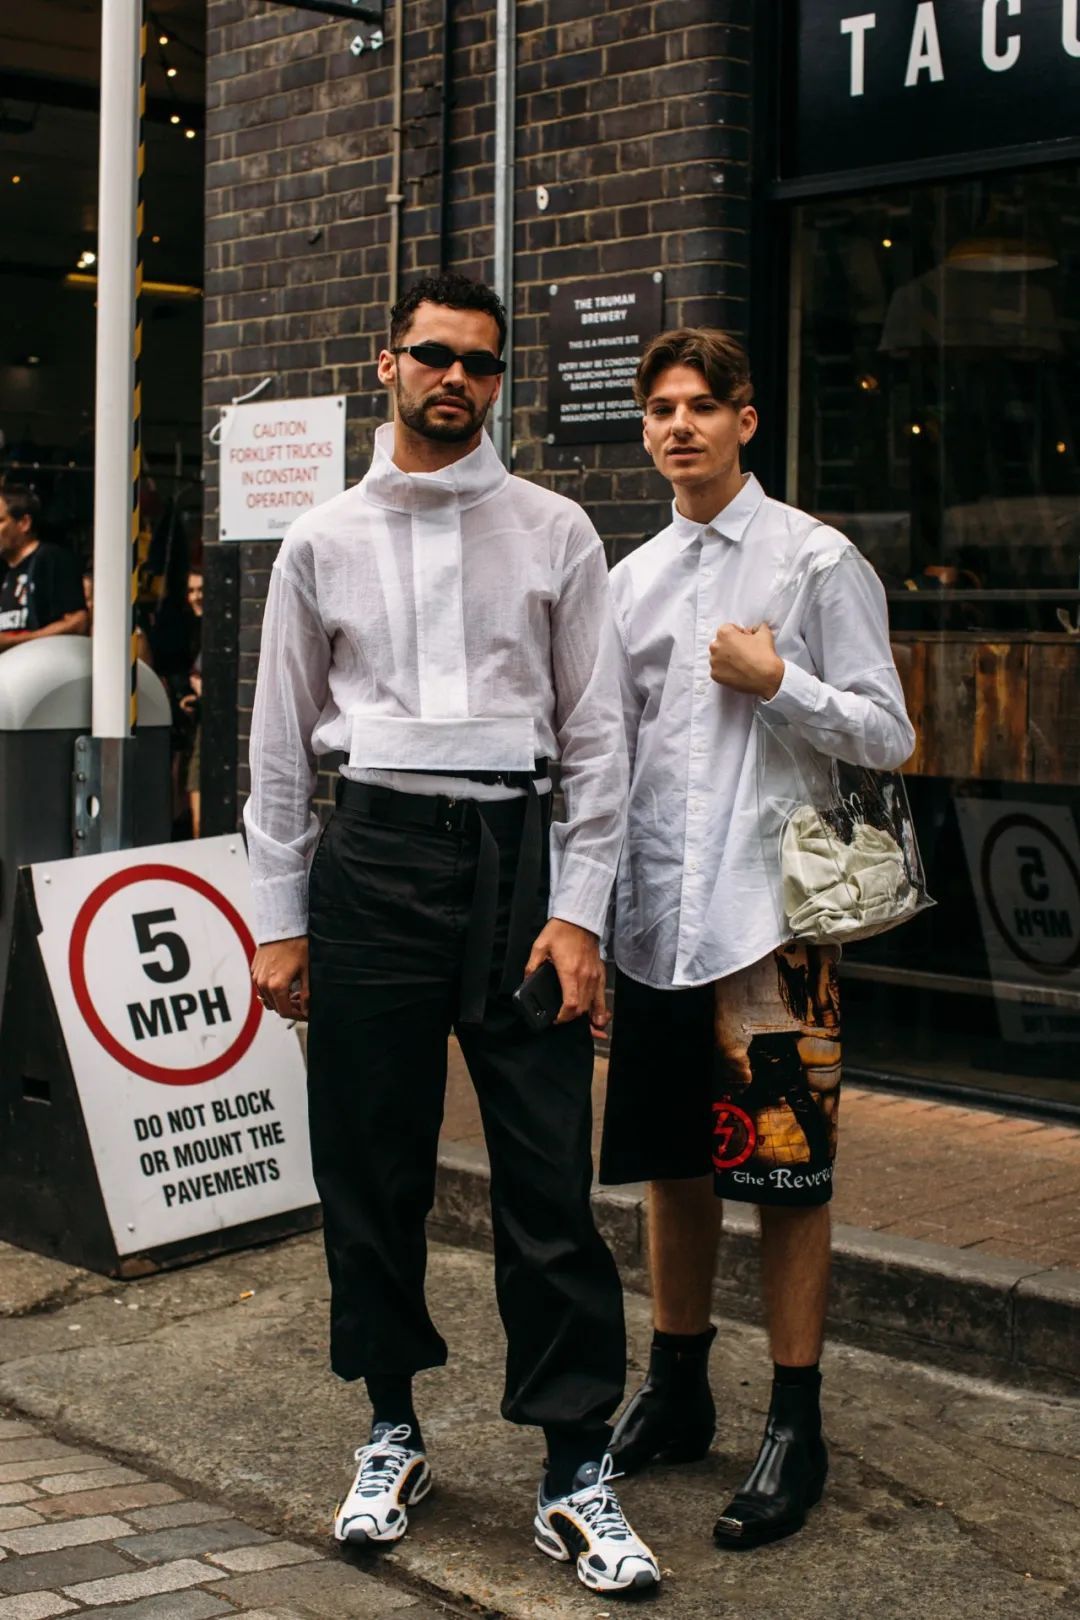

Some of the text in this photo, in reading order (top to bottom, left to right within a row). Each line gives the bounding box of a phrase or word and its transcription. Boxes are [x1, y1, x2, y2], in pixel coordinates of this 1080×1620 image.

[574, 293, 636, 310] THE TRUMAN
[581, 309, 627, 325] BREWERY
[568, 334, 639, 350] THIS IS A PRIVATE SITE
[558, 361, 578, 372] ENTRY
[562, 372, 573, 381] ON
[574, 369, 611, 380] SEARCHING
[588, 380, 604, 389] AND
[560, 403, 581, 413] ENTRY
[253, 420, 307, 438] CAUTION
[230, 441, 333, 463] FORKLIFT TRUCKS
[242, 466, 320, 486] IN CONSTANT
[246, 491, 314, 509] OPERATION
[131, 907, 191, 985] 5
[126, 986, 232, 1041] MPH
[134, 1088, 275, 1142] DO NOT BLOCK
[140, 1121, 285, 1177] OR MOUNT THE
[162, 1158, 280, 1207] PAVEMENTS
[731, 1170, 765, 1185] The
